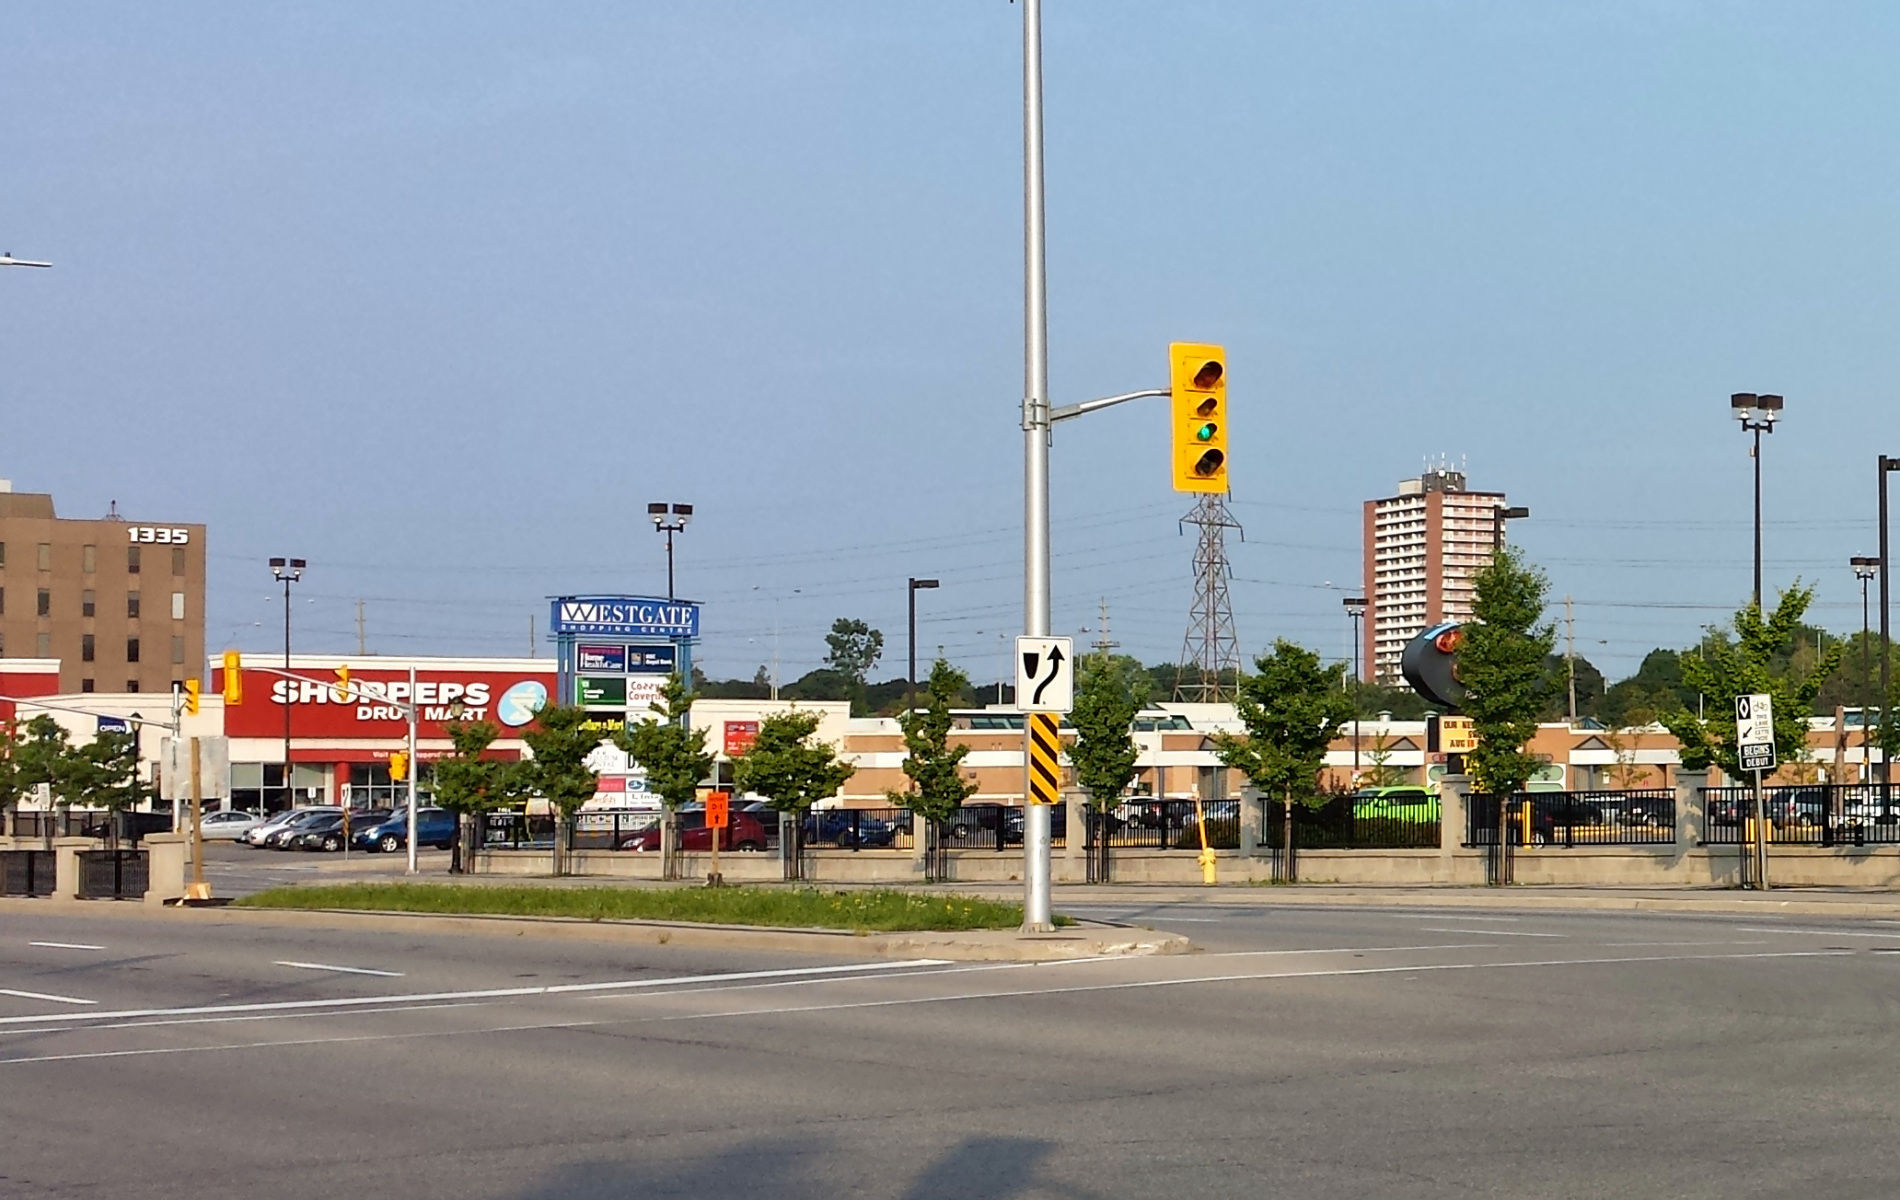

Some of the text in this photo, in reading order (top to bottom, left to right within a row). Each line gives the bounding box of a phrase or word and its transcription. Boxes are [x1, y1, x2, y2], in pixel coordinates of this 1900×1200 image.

[127, 526, 189, 545] 1335
[561, 602, 693, 625] WESTGATE
[561, 624, 631, 633] SHOPPING
[270, 679, 491, 706] SHOPPERS
[1450, 740, 1466, 748] AUG
[1743, 744, 1770, 756] BEGINS
